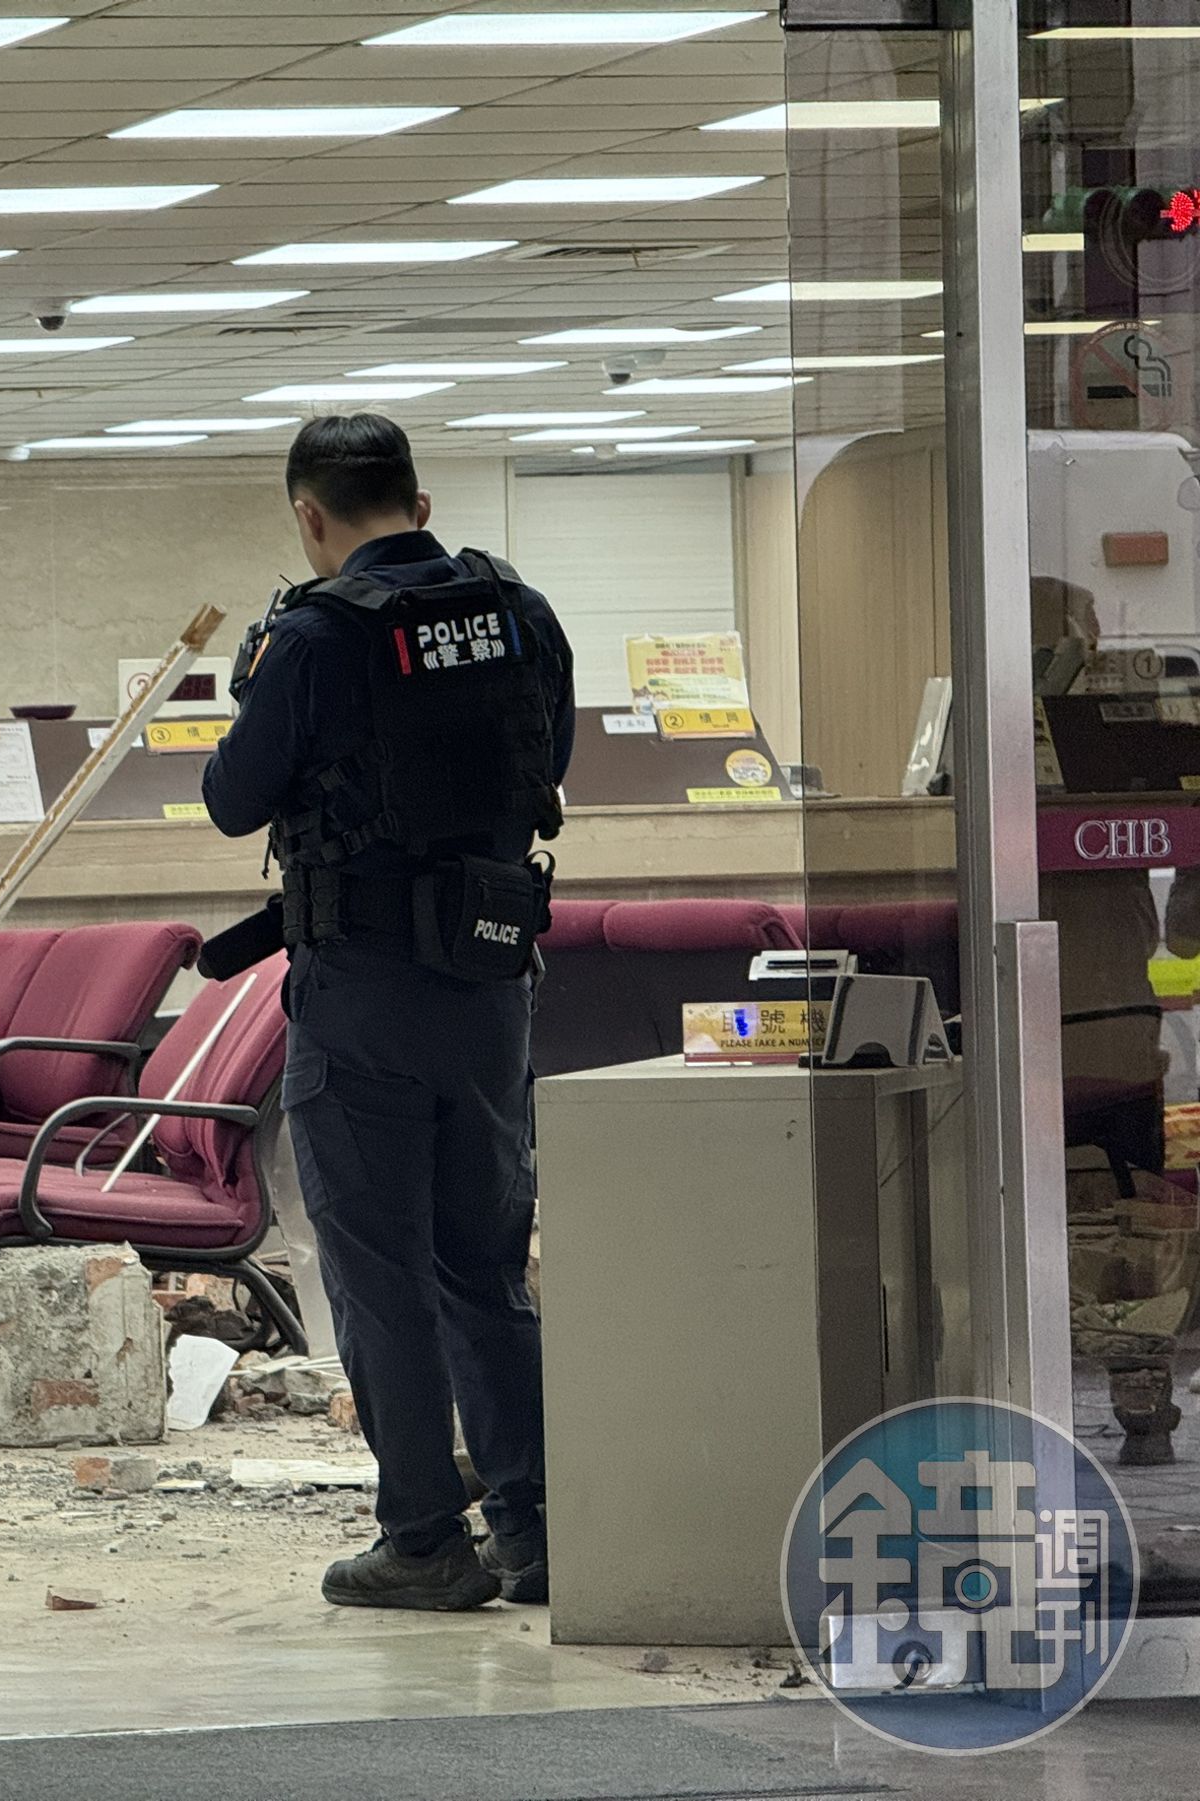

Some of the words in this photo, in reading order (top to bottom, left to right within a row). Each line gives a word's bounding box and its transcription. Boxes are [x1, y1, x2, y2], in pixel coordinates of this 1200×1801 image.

[417, 612, 501, 649] POLICE
[437, 638, 493, 668] 警察
[1074, 818, 1172, 860] CHB
[474, 919, 520, 945] POLICE
[721, 1039, 752, 1048] PLEASE
[754, 1039, 776, 1047] TAKE
[778, 1039, 785, 1047] A
